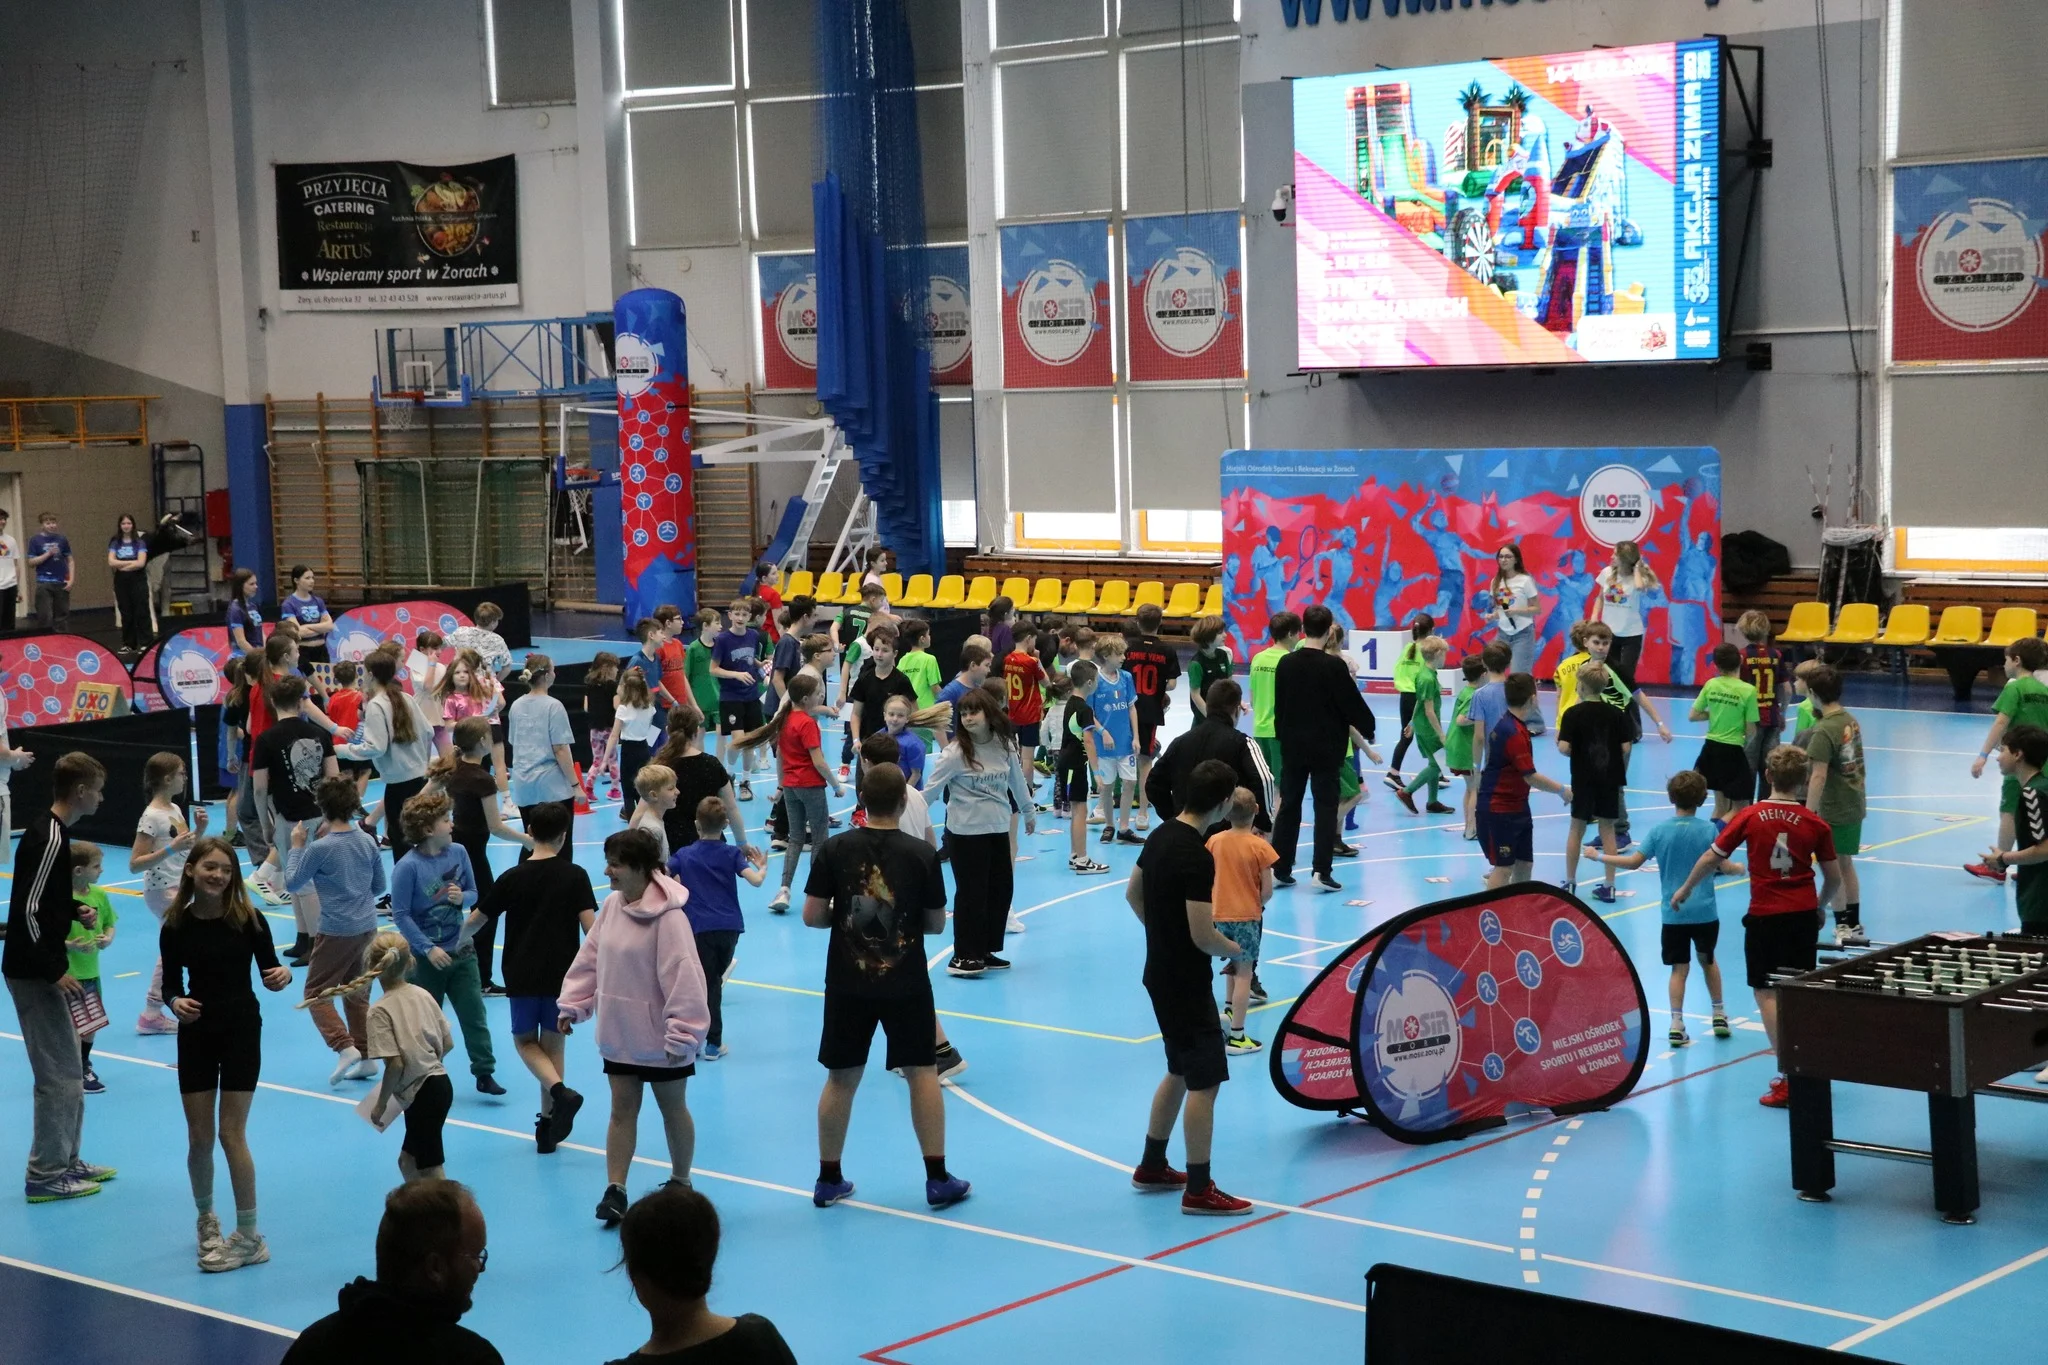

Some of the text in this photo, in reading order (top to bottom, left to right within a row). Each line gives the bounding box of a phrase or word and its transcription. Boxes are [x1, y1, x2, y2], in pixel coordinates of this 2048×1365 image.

[1684, 82, 1703, 260] AKCJA ZIMA
[303, 178, 388, 199] PRZYJĘCIA
[314, 201, 375, 216] CATERING
[317, 220, 374, 232] Restauracja
[312, 263, 488, 285] Wspieramy sport w Żorach
[323, 295, 352, 304] Rybnicka
[1247, 464, 1272, 473] Ośrodek
[1273, 465, 1294, 473] Sportu
[1298, 465, 1326, 474] Rekreacji
[1333, 464, 1356, 473] Żorach
[853, 617, 867, 639] 7
[1361, 638, 1377, 670] 1
[1005, 672, 1024, 701] 19
[1132, 663, 1159, 696] 10
[1752, 668, 1776, 700] 11
[1128, 755, 1136, 767] 8
[1758, 808, 1802, 826] HEINZE
[1770, 832, 1793, 879] 4
[1552, 1020, 1622, 1050] MIEJSKI OŚRODEK
[1394, 1045, 1446, 1062] www.mosir.zory.pl
[1540, 1037, 1622, 1071] SPORTU I REKREACJI
[1577, 1054, 1621, 1075] W ŻORACH
